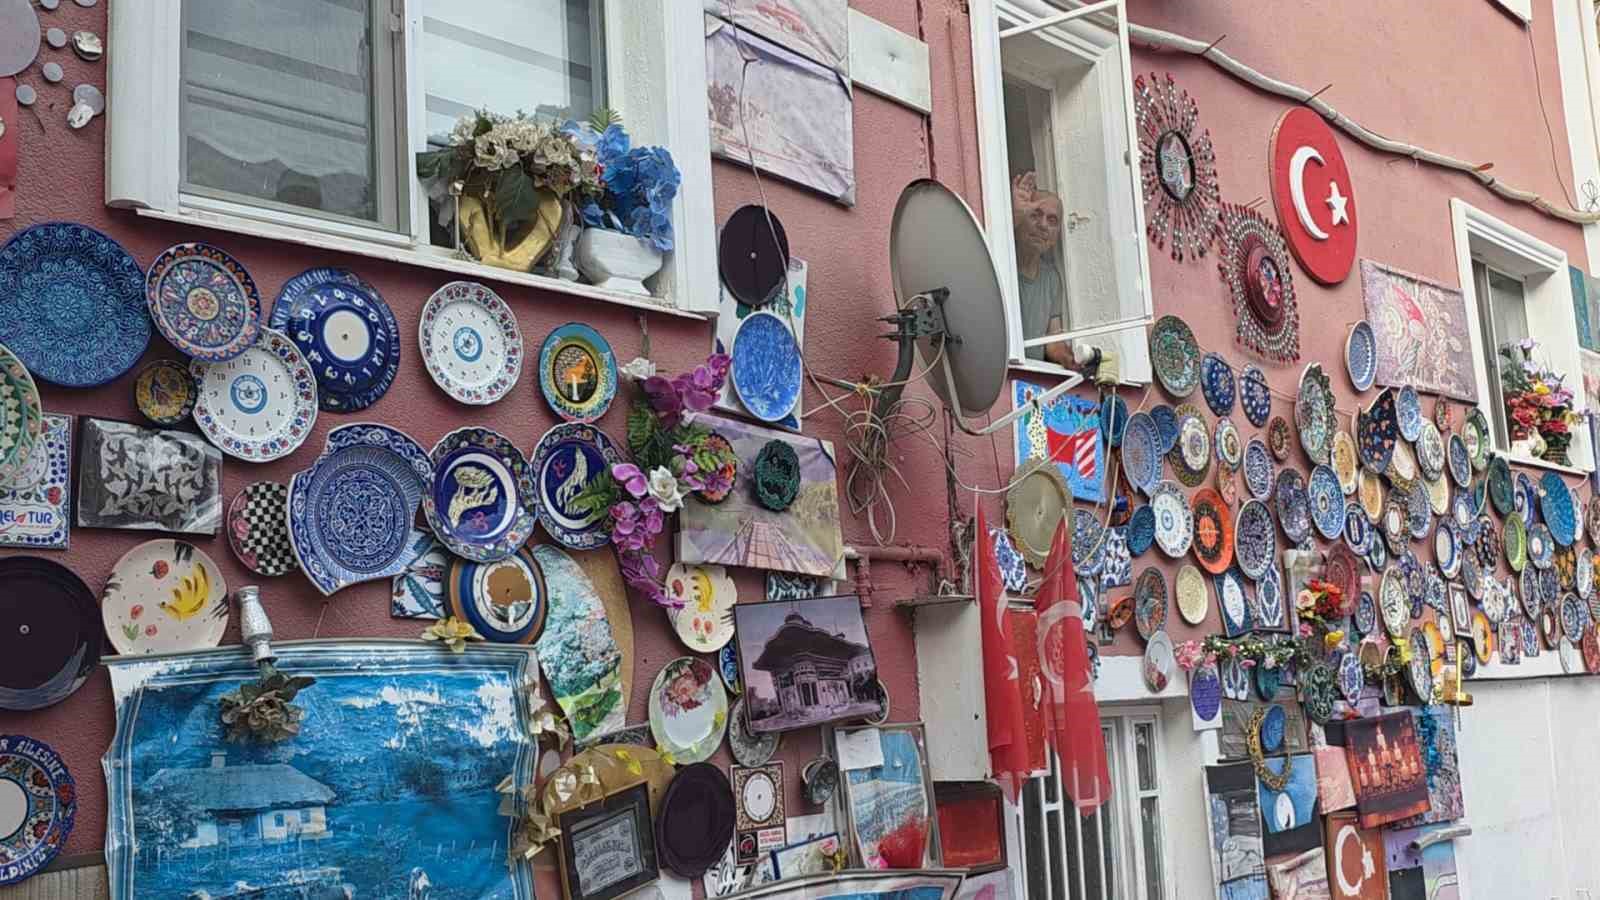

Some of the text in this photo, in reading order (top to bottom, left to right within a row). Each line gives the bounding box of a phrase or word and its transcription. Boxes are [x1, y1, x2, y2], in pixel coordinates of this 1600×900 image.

[314, 294, 328, 306] 7
[301, 308, 316, 320] 6
[298, 330, 313, 344] 5
[307, 349, 322, 363] 4
[325, 366, 338, 379] 3
[344, 372, 356, 385] 2
[362, 367, 372, 377] 1
[28, 511, 53, 524] TUR
